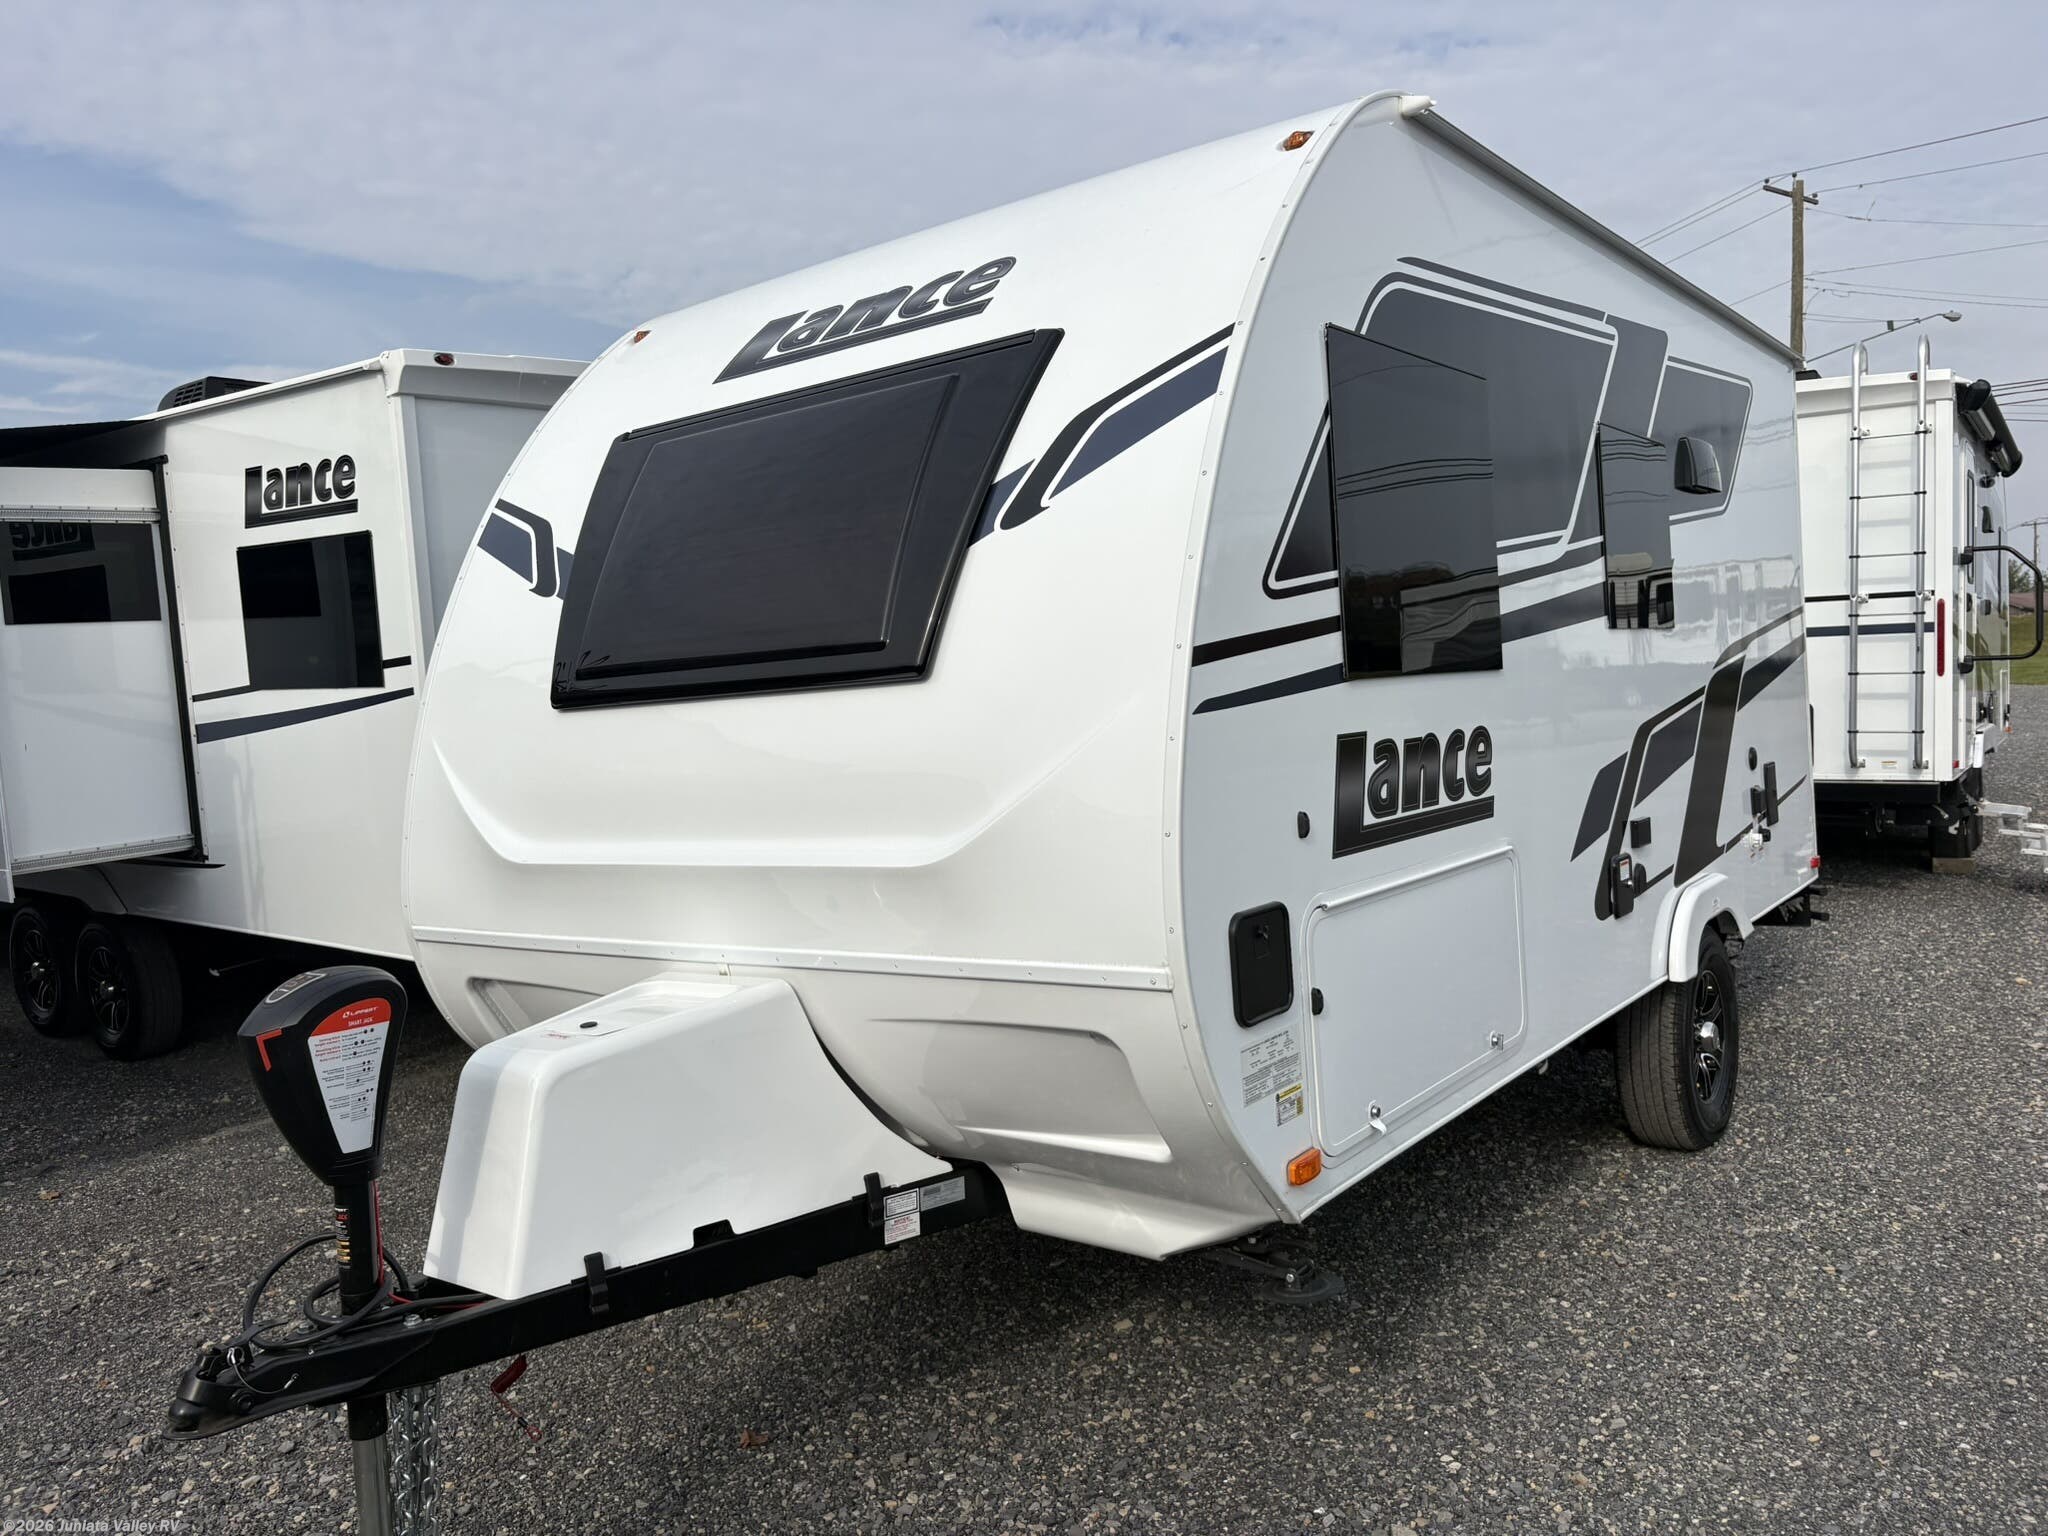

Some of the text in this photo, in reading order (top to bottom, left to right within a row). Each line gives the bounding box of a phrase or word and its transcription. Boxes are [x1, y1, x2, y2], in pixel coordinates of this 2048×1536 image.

[712, 256, 1017, 384] Lance
[245, 455, 358, 529] Lance
[1332, 725, 1495, 859] Lance
